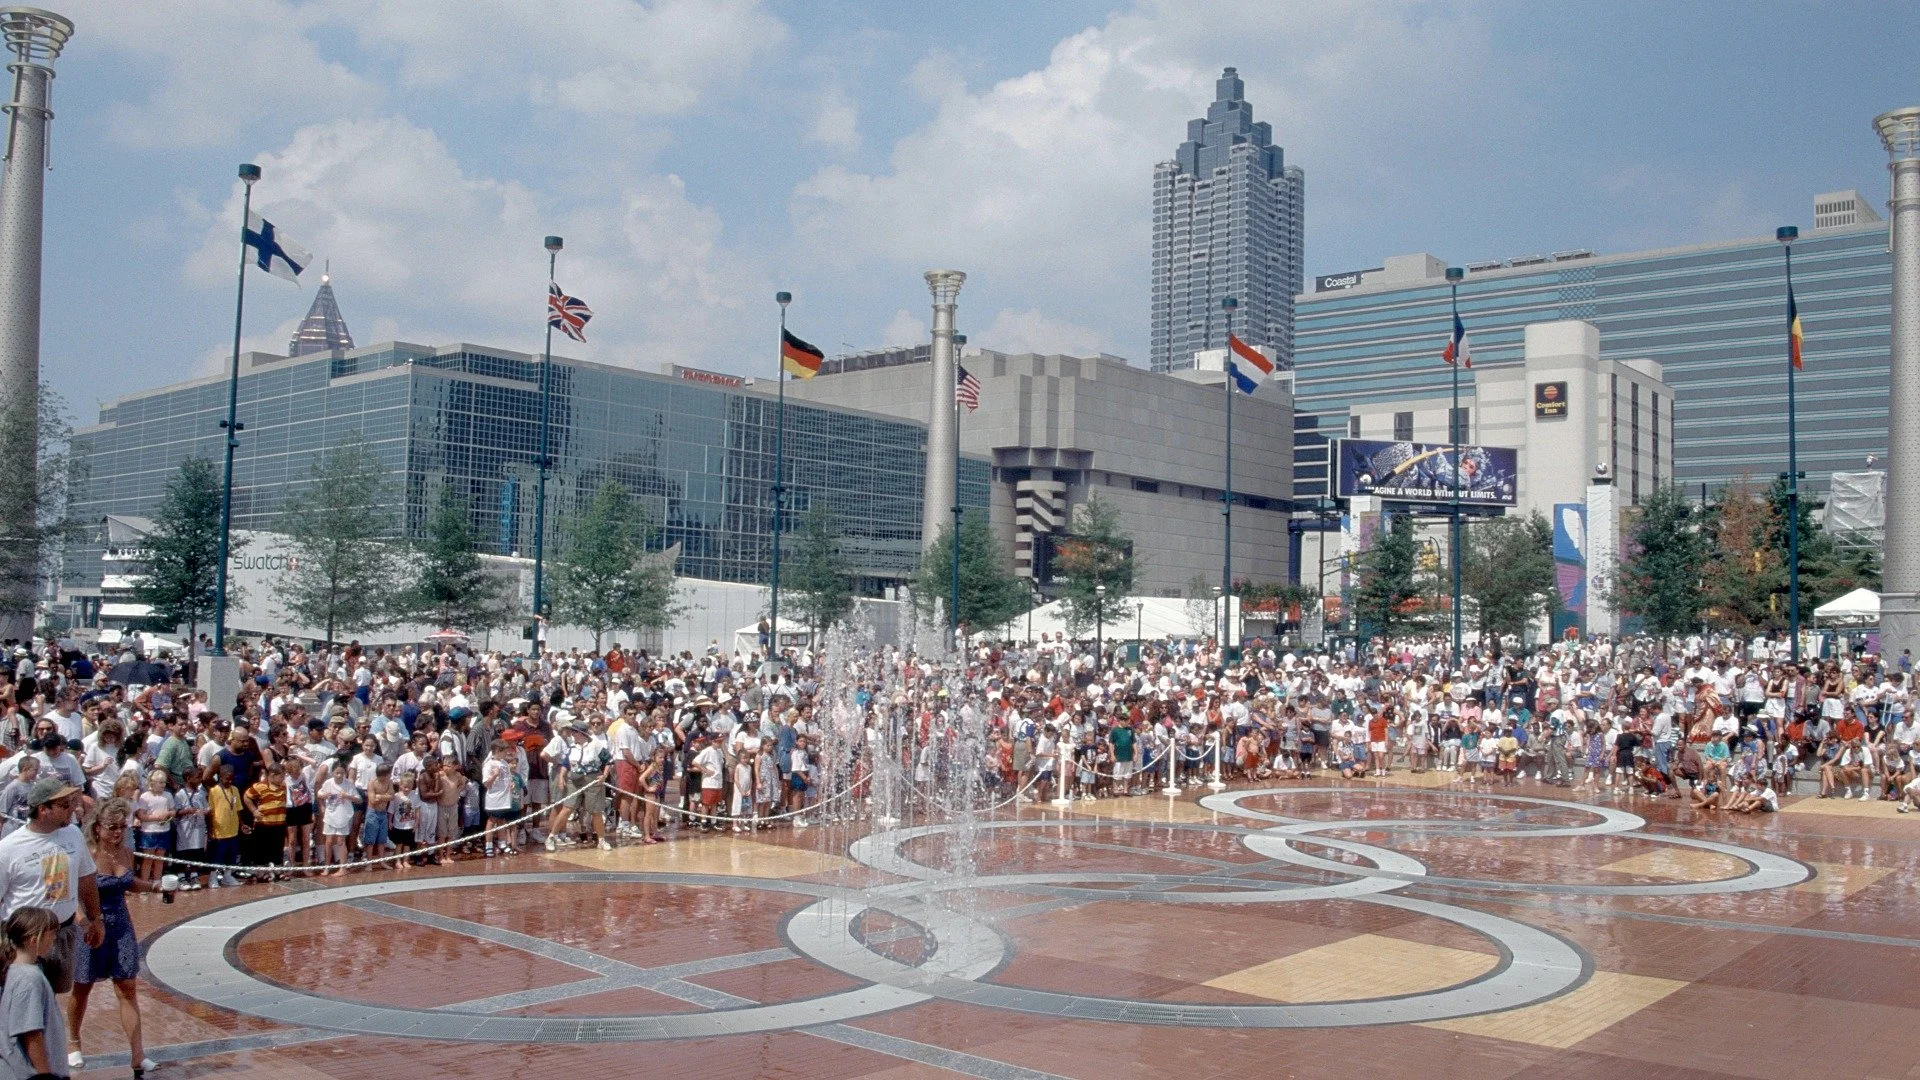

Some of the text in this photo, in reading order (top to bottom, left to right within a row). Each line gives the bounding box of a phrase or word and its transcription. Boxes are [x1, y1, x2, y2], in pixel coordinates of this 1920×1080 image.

[1325, 275, 1357, 288] Coastal
[1405, 488, 1432, 497] WORLD
[1434, 489, 1469, 498] WITHUT
[233, 553, 288, 570] swatch
